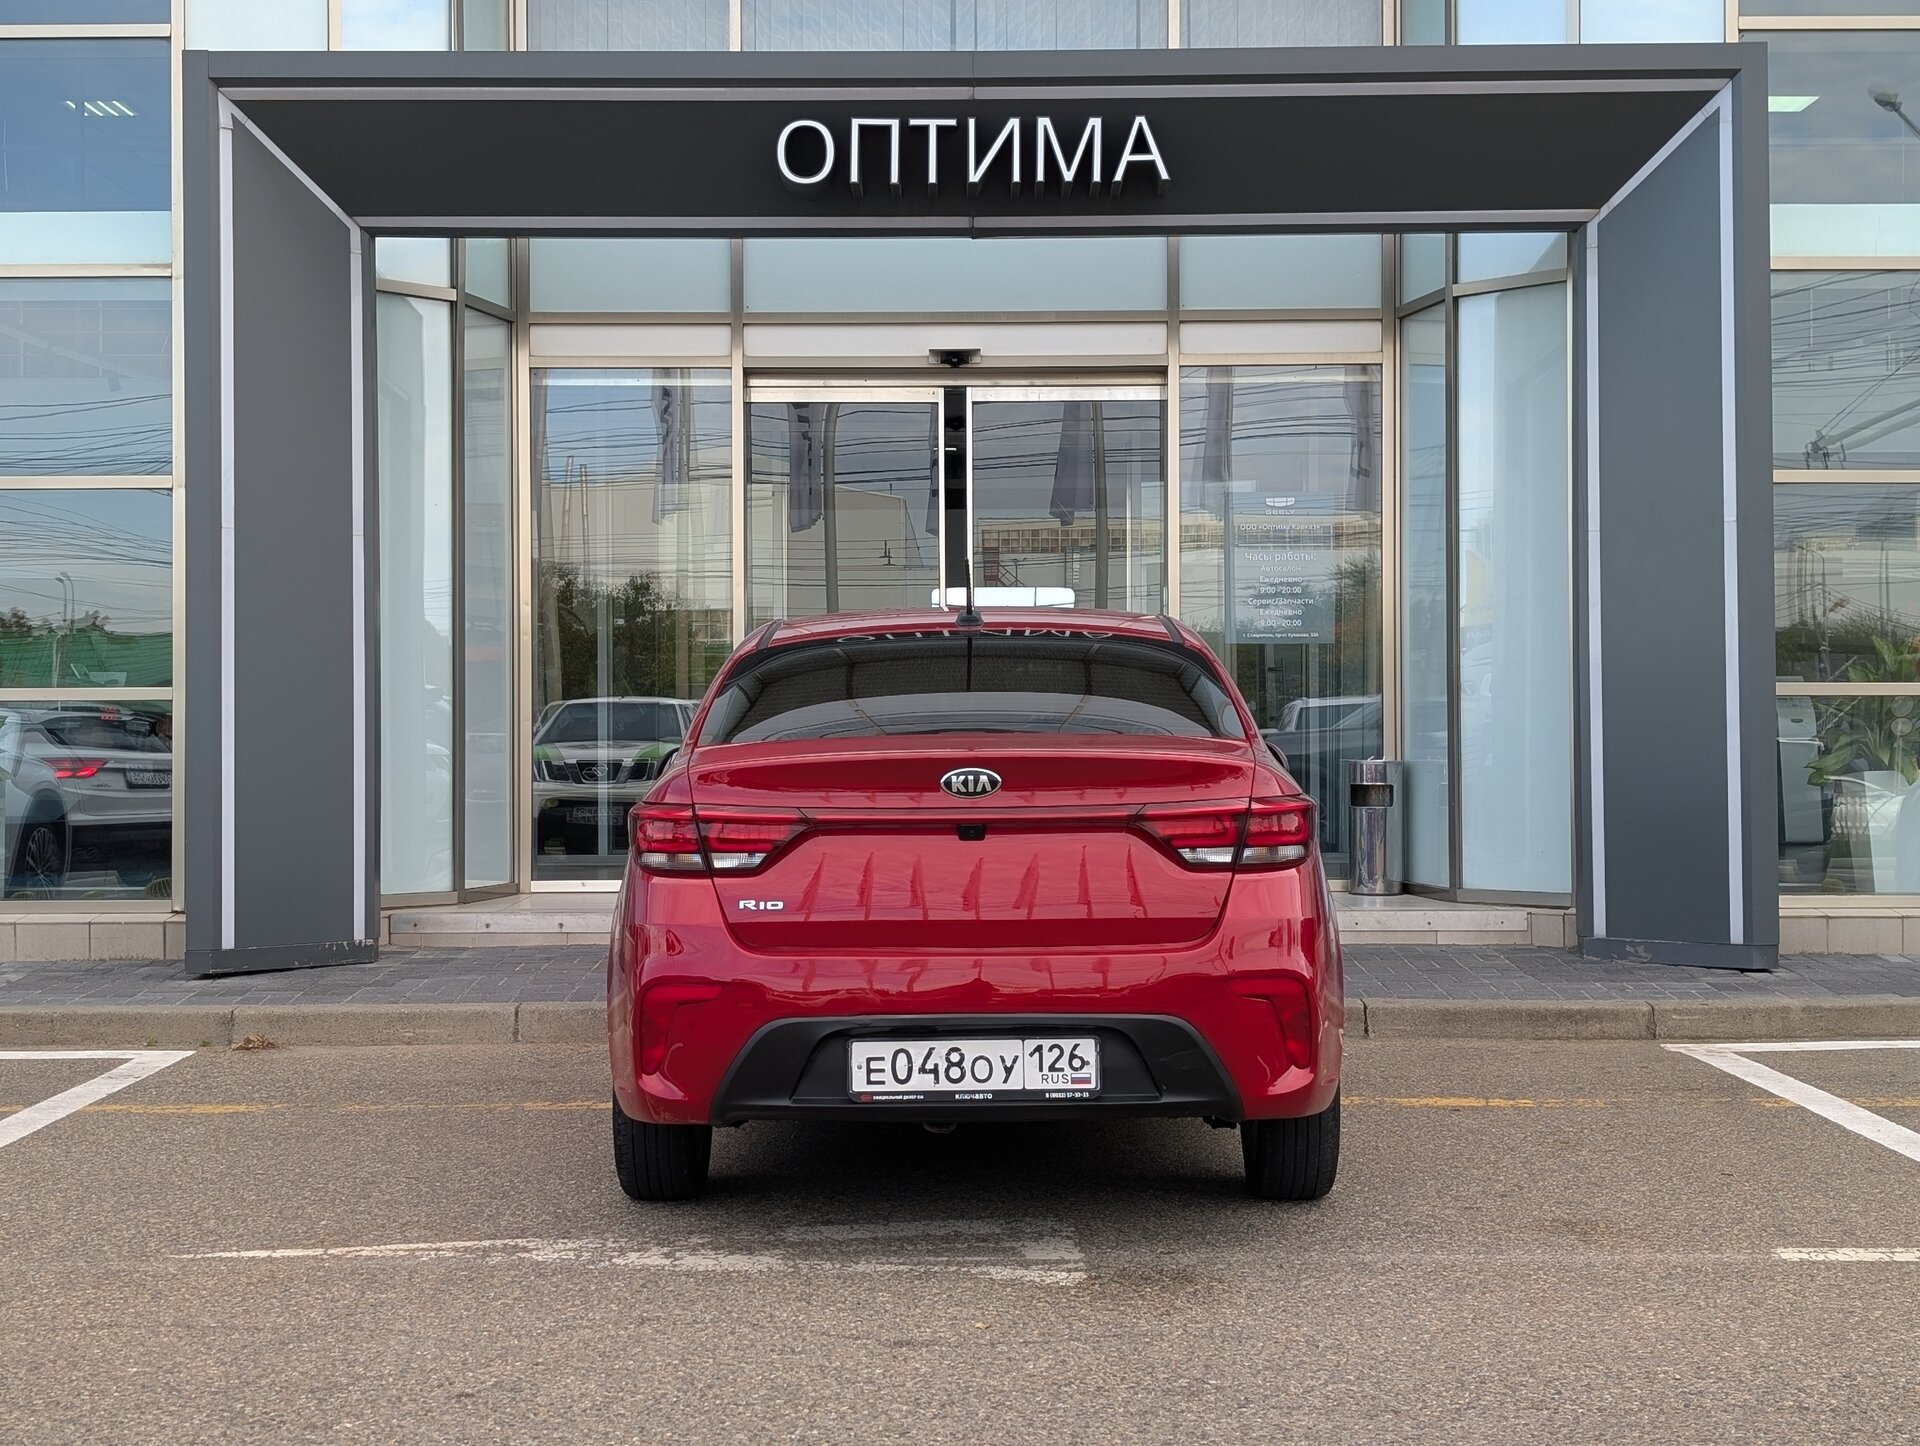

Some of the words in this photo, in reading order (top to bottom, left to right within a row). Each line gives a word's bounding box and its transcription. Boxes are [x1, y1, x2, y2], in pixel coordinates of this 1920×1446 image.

[776, 115, 1170, 186] ОПТИМА
[1244, 552, 1272, 561] Часы
[1274, 551, 1316, 563] работы:
[1260, 576, 1303, 584] Ежедневно
[1248, 597, 1314, 606] Сервис/Запчасти
[1260, 609, 1303, 617] Ежедневно
[950, 775, 992, 793] KIA
[739, 900, 784, 911] RIO
[1028, 1043, 1086, 1073] 126
[1041, 1073, 1069, 1084] RUS
